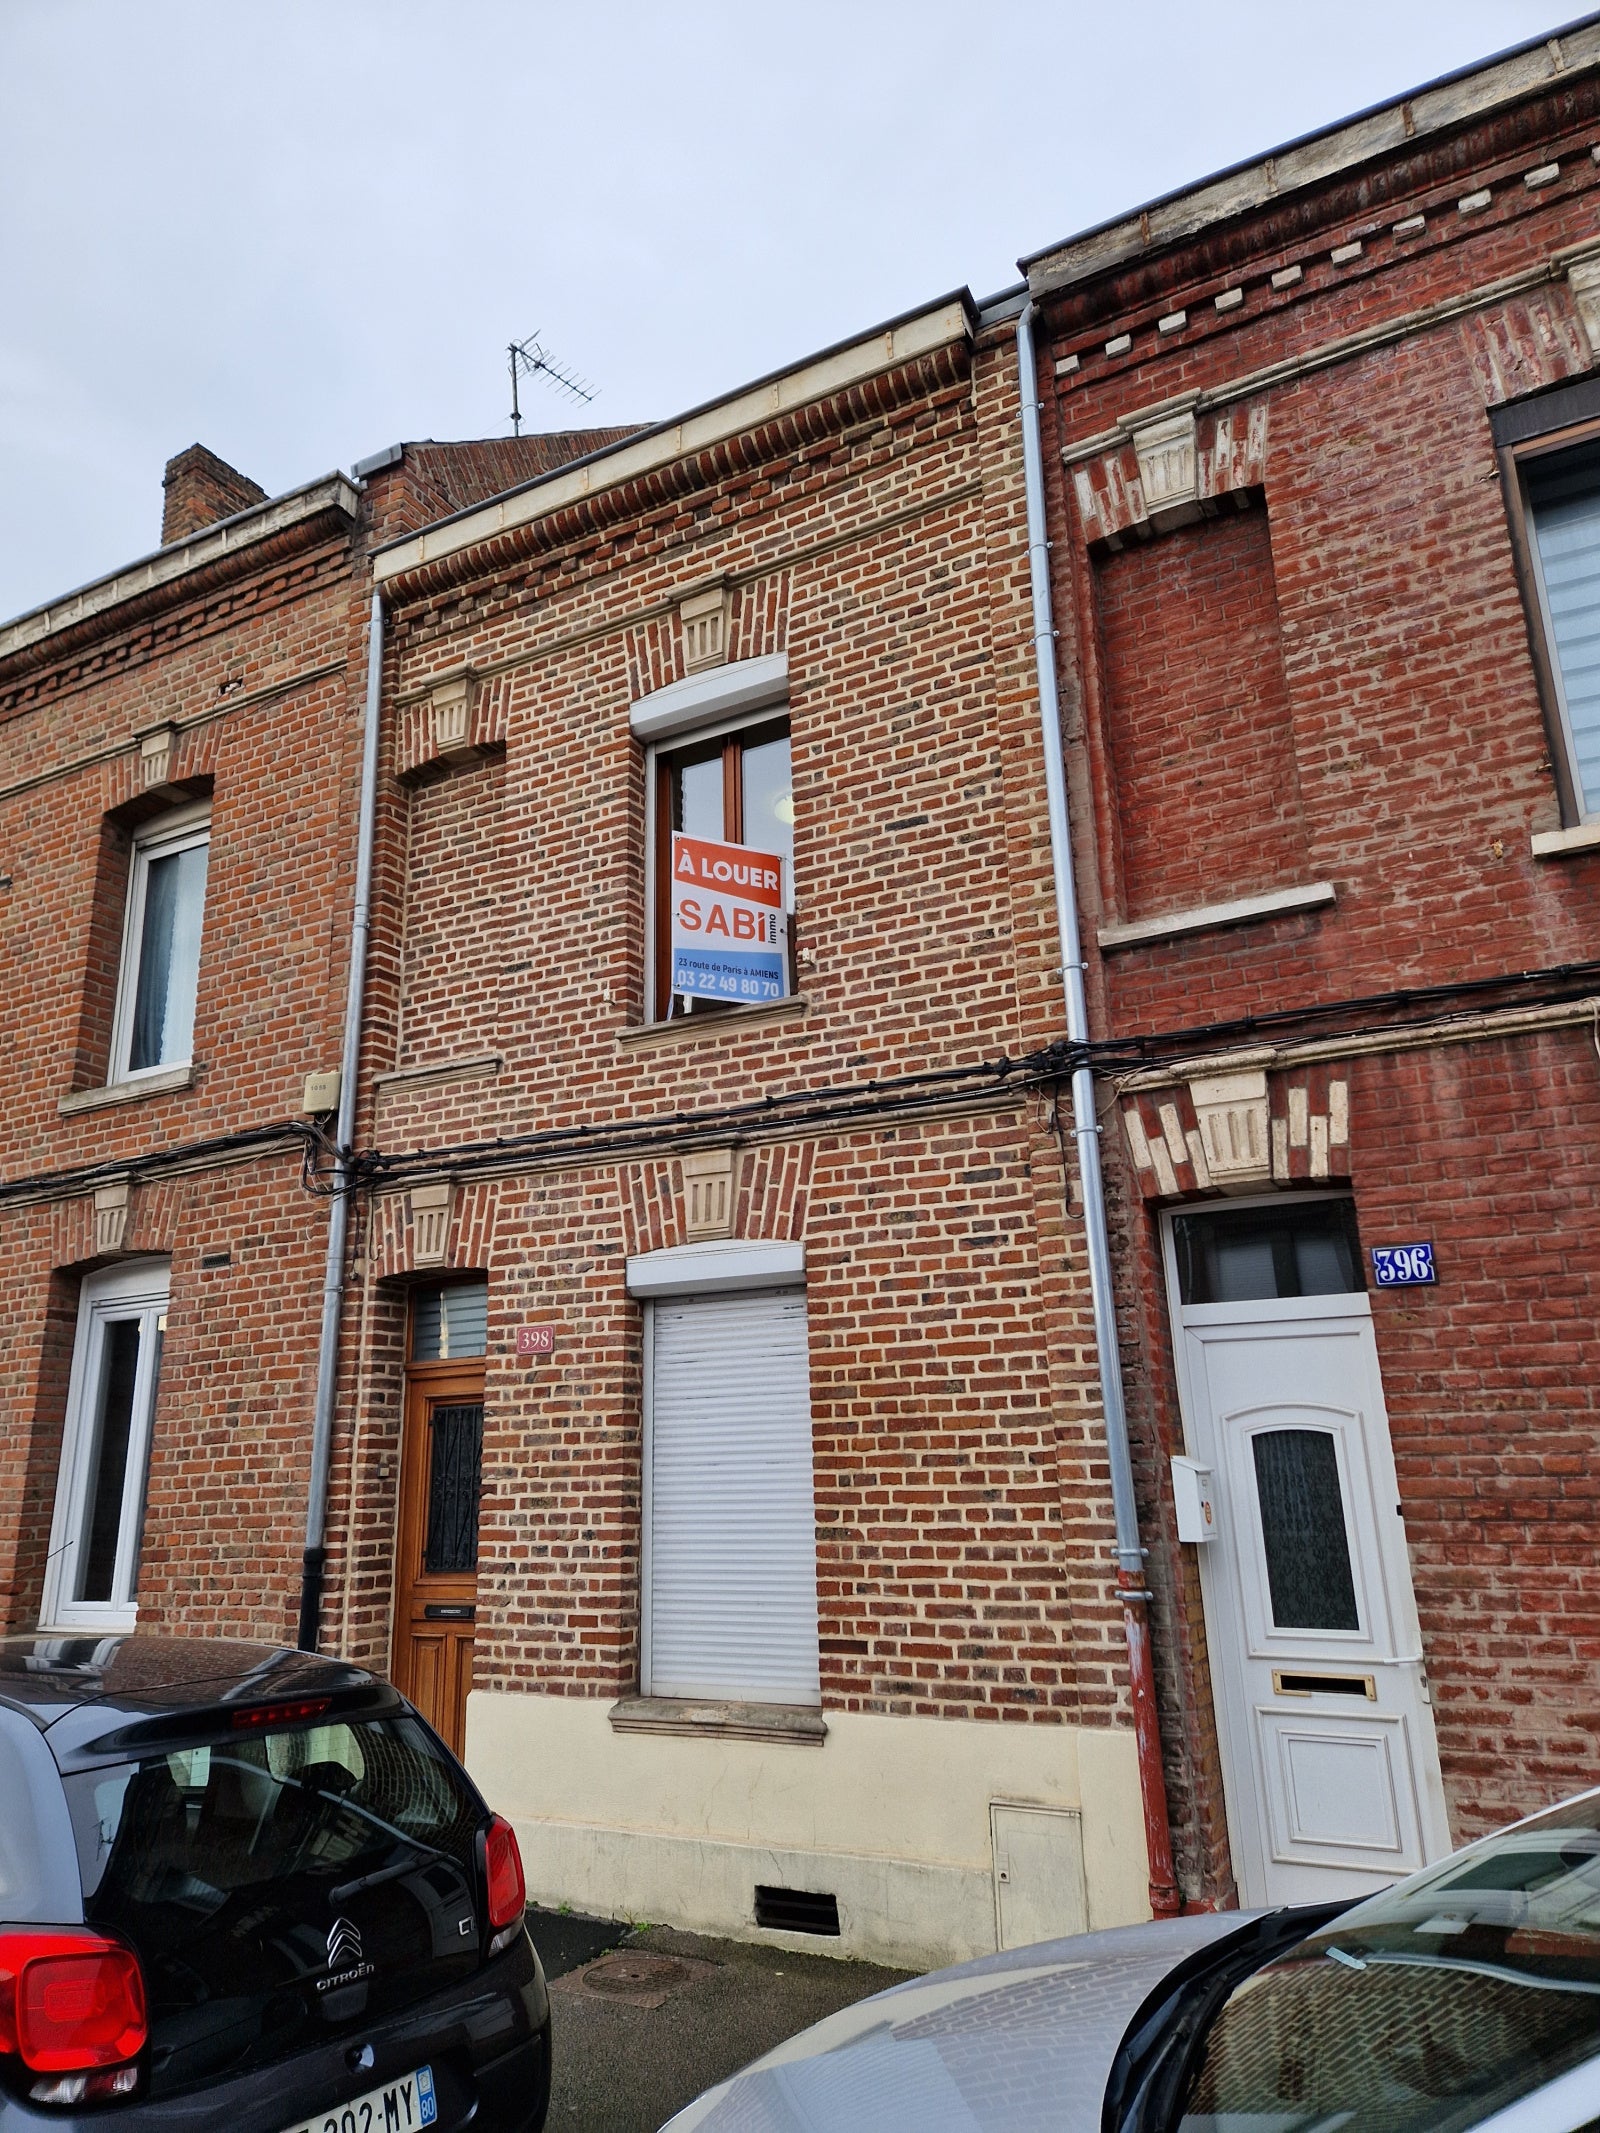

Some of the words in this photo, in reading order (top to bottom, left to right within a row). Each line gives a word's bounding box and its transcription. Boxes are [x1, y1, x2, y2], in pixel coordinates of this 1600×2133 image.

[677, 848, 696, 876] À
[701, 857, 778, 891] LOUER
[768, 913, 776, 944] immo
[678, 957, 688, 966] 23
[689, 960, 709, 970] route
[711, 962, 720, 971] de
[723, 964, 741, 974] Paris
[750, 968, 779, 980] AMIENS
[677, 969, 695, 986] 03
[698, 972, 716, 990] 22
[719, 975, 737, 992] 49
[741, 978, 759, 995] 80
[762, 981, 779, 997] 70
[1376, 1248, 1429, 1281] 396
[521, 1330, 549, 1349] 398
[421, 2096, 435, 2119] 80
